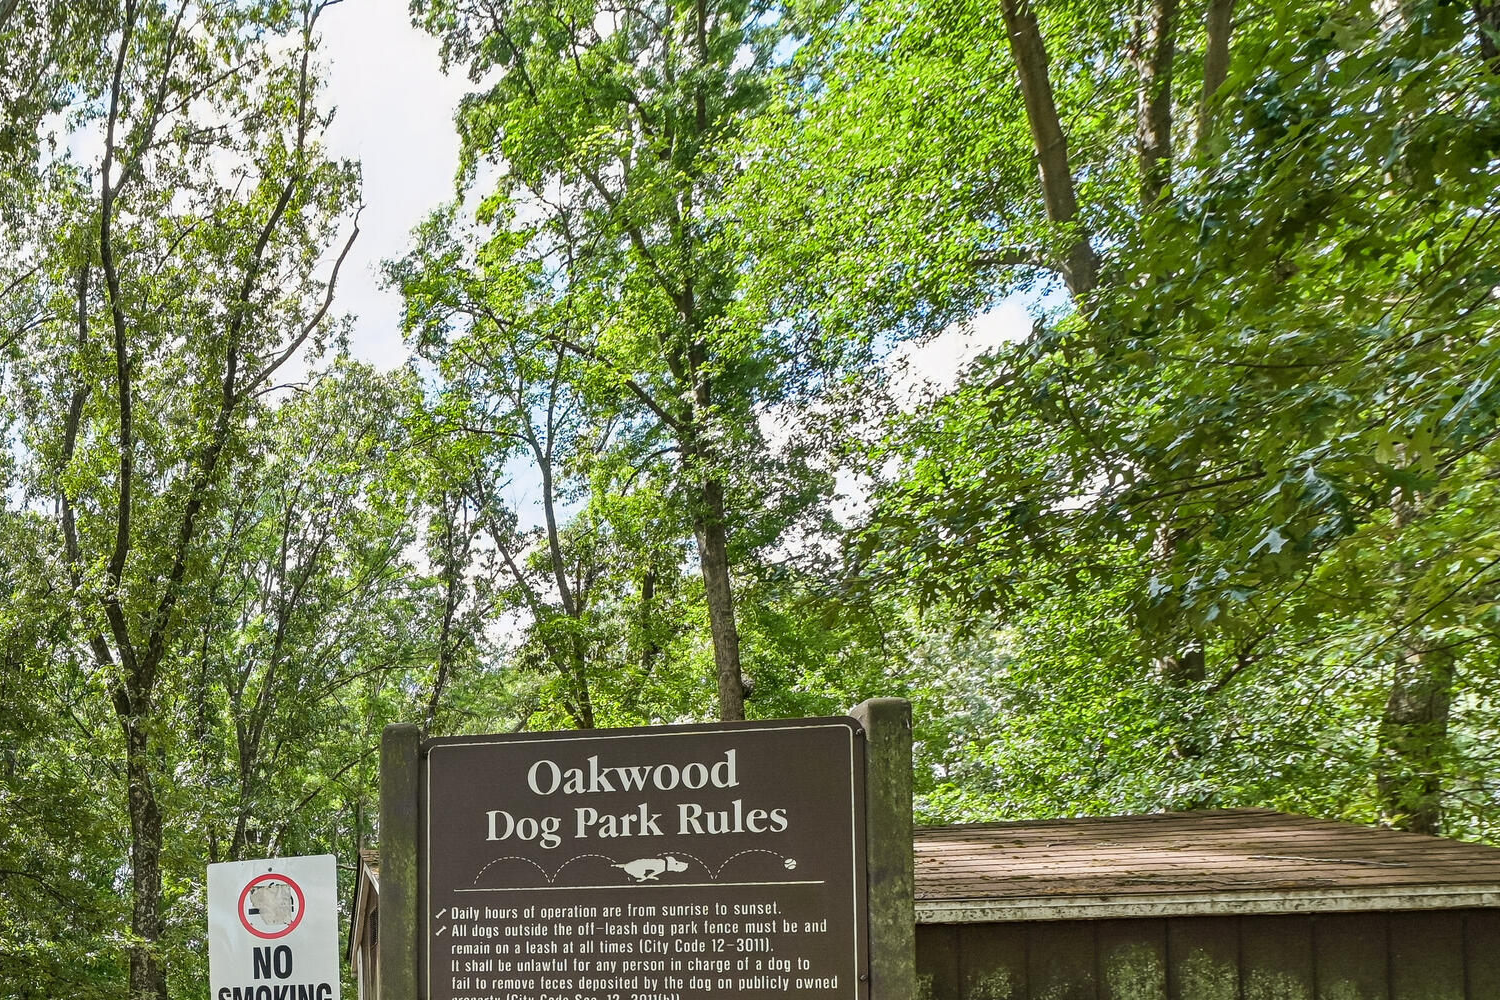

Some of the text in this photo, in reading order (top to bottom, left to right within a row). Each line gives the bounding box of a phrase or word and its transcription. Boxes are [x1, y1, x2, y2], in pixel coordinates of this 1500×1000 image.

[527, 746, 739, 797] Oakwood
[485, 796, 788, 851] Dog Park Rules
[451, 900, 781, 922] Daily hours of operation are from sunrise to sunset.
[451, 923, 466, 937] All
[471, 923, 499, 939] dogs
[504, 922, 548, 937] outside
[553, 922, 572, 936] the
[642, 920, 664, 937] dog
[670, 920, 697, 936] park
[703, 919, 738, 934] fence
[745, 919, 776, 933] must
[782, 918, 798, 933] be
[804, 918, 827, 933] and
[451, 941, 490, 955] remain
[495, 943, 509, 954] on
[514, 943, 520, 954] a
[526, 940, 557, 954] leash
[562, 940, 573, 953] at
[579, 939, 593, 953] all
[599, 939, 633, 953] times
[639, 937, 669, 955] (City
[674, 938, 705, 953] Code
[253, 945, 293, 980] NO
[451, 956, 810, 973] It shall be unlawful for any person in charge of a dog to
[451, 974, 837, 992] fail to remove feces deposited by the dog on publicly owned
